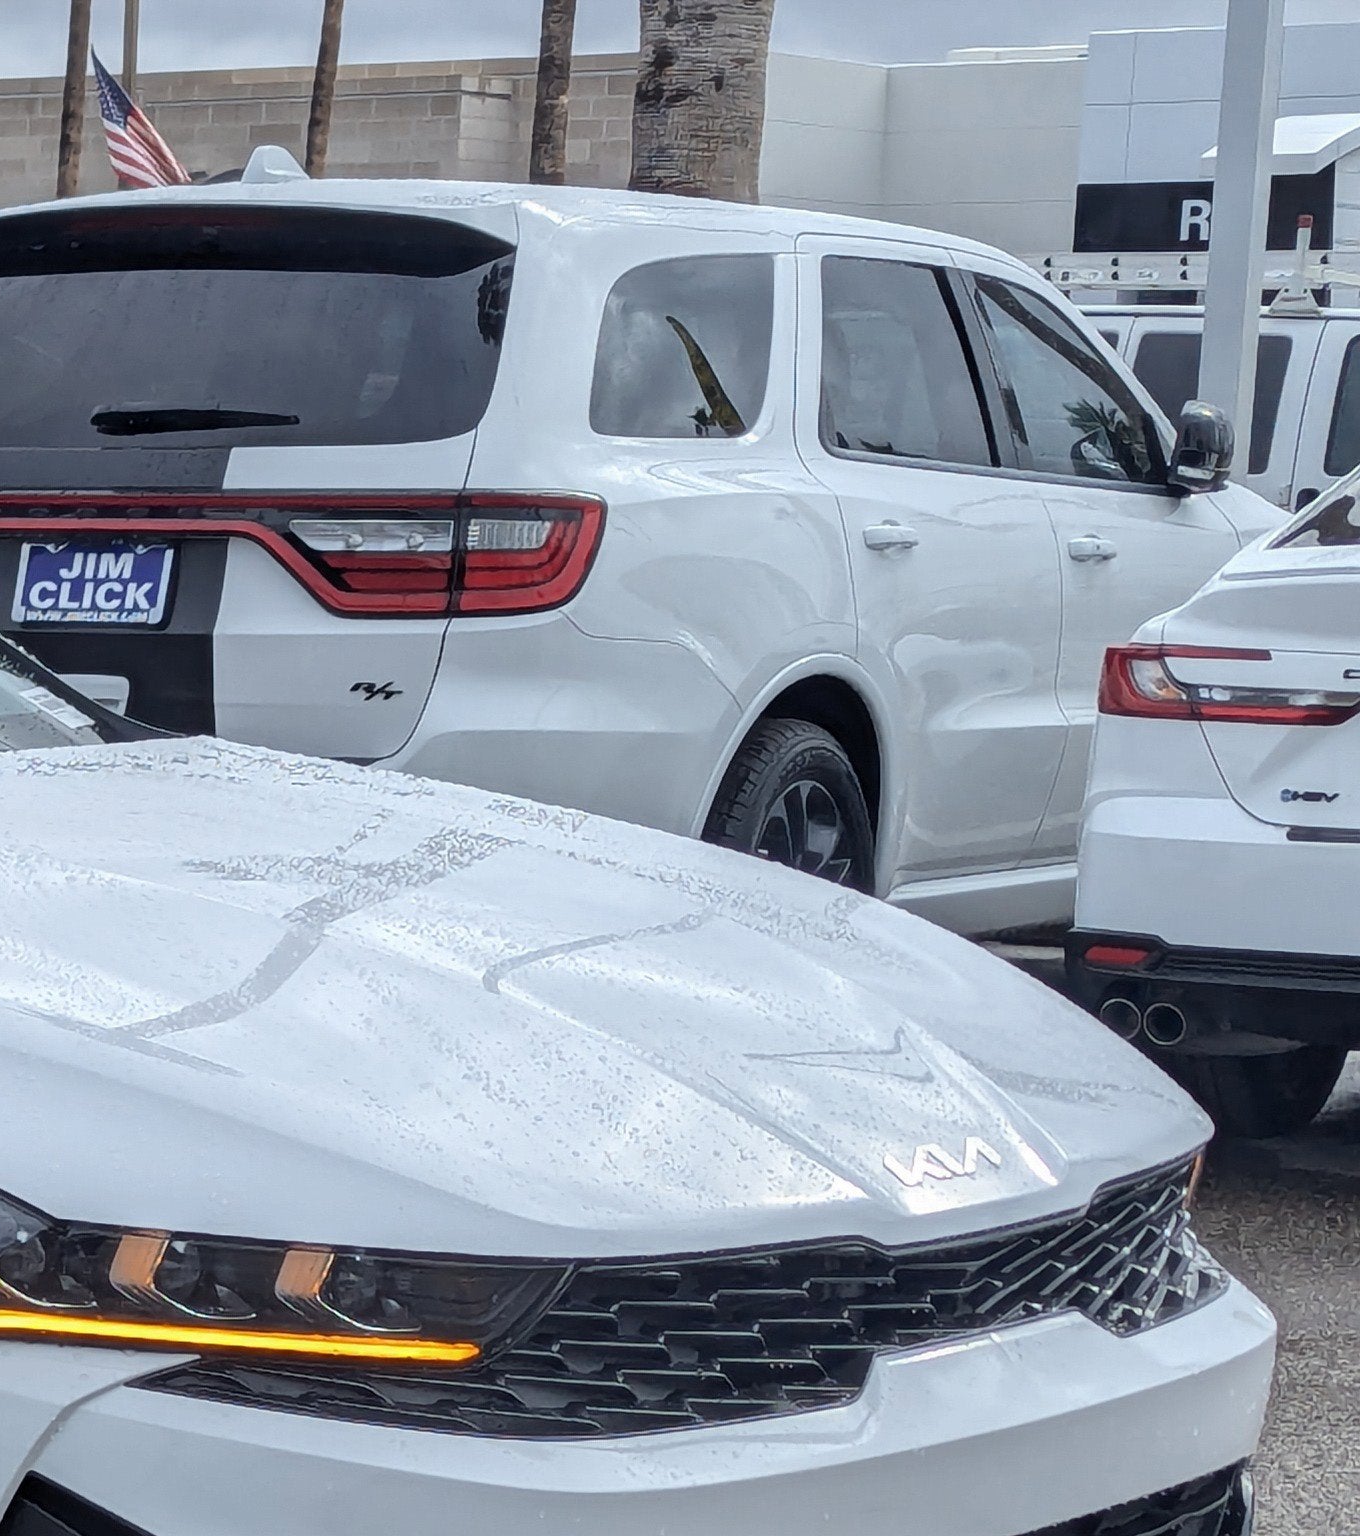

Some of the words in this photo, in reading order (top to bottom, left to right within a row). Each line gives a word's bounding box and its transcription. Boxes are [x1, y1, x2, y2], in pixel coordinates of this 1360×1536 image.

[58, 552, 135, 579] JIM
[28, 581, 154, 609] CLICK
[348, 681, 403, 701] R/T
[882, 1136, 1002, 1188] KIA
